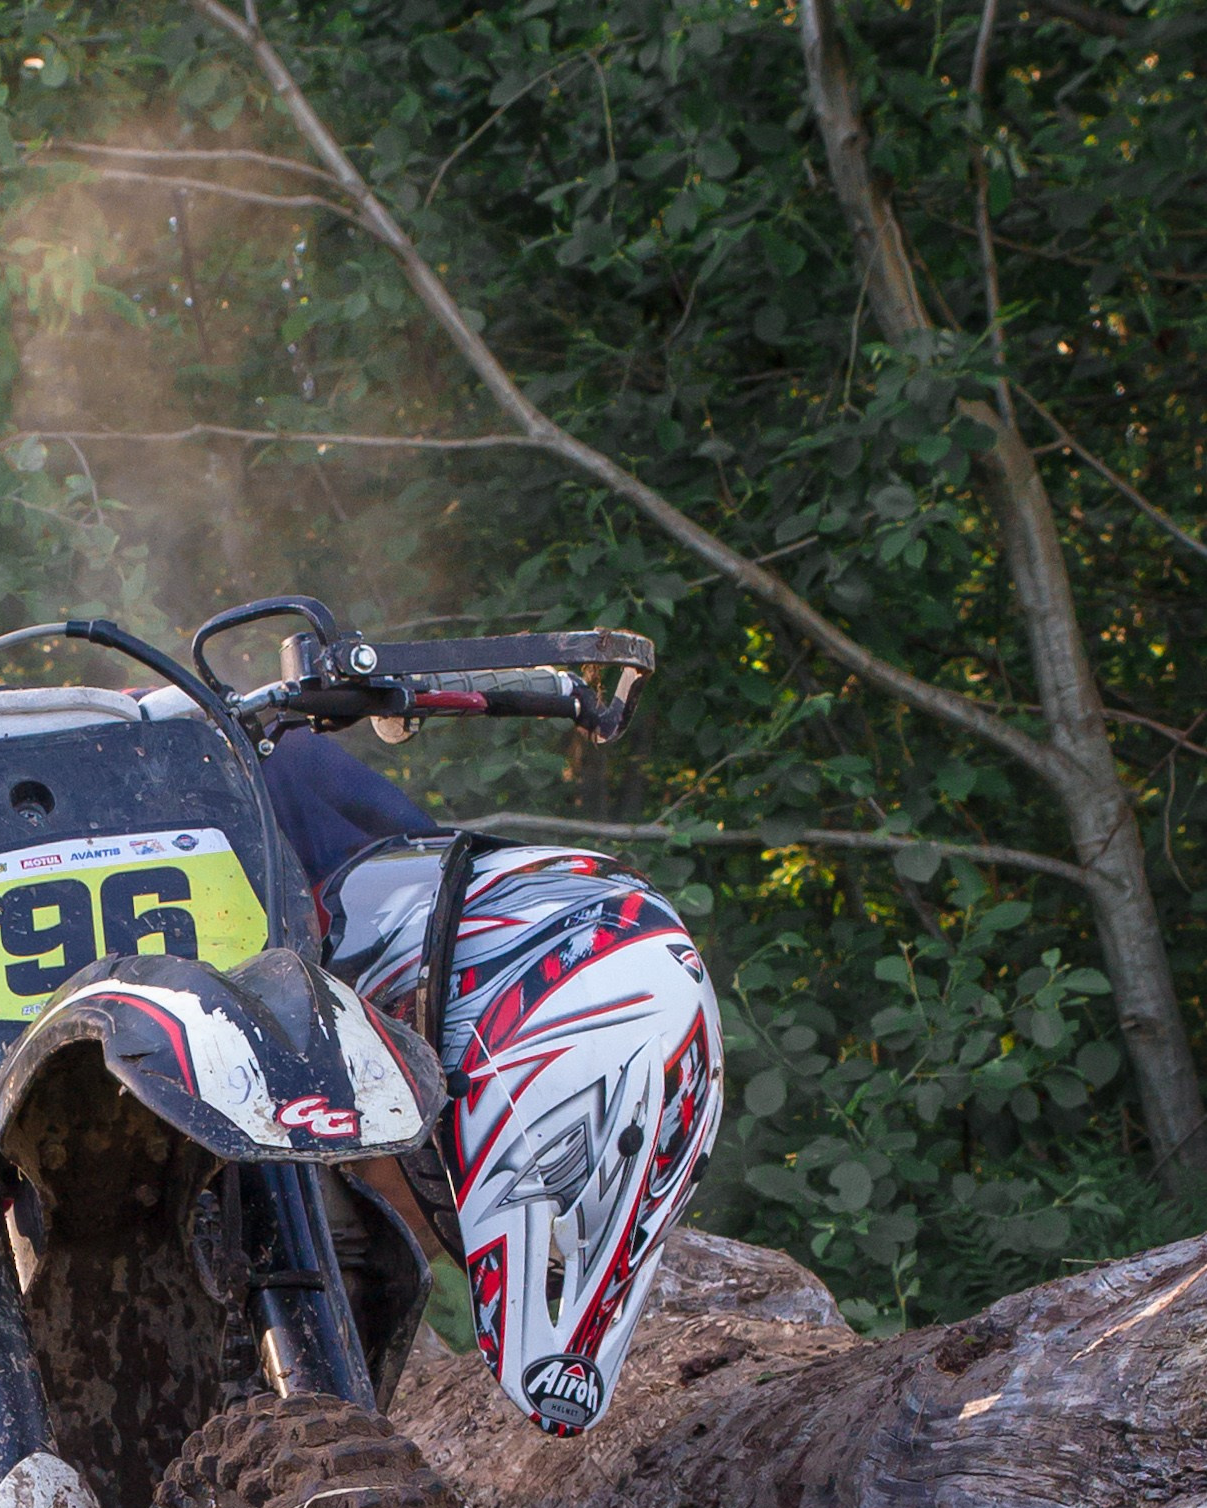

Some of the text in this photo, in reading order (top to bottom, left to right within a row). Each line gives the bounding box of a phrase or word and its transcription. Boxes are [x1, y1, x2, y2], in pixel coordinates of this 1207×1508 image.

[22, 856, 60, 869] MOTUL
[0, 866, 198, 996] 96
[527, 1360, 598, 1413] Airoh
[550, 1403, 579, 1417] HELMET
